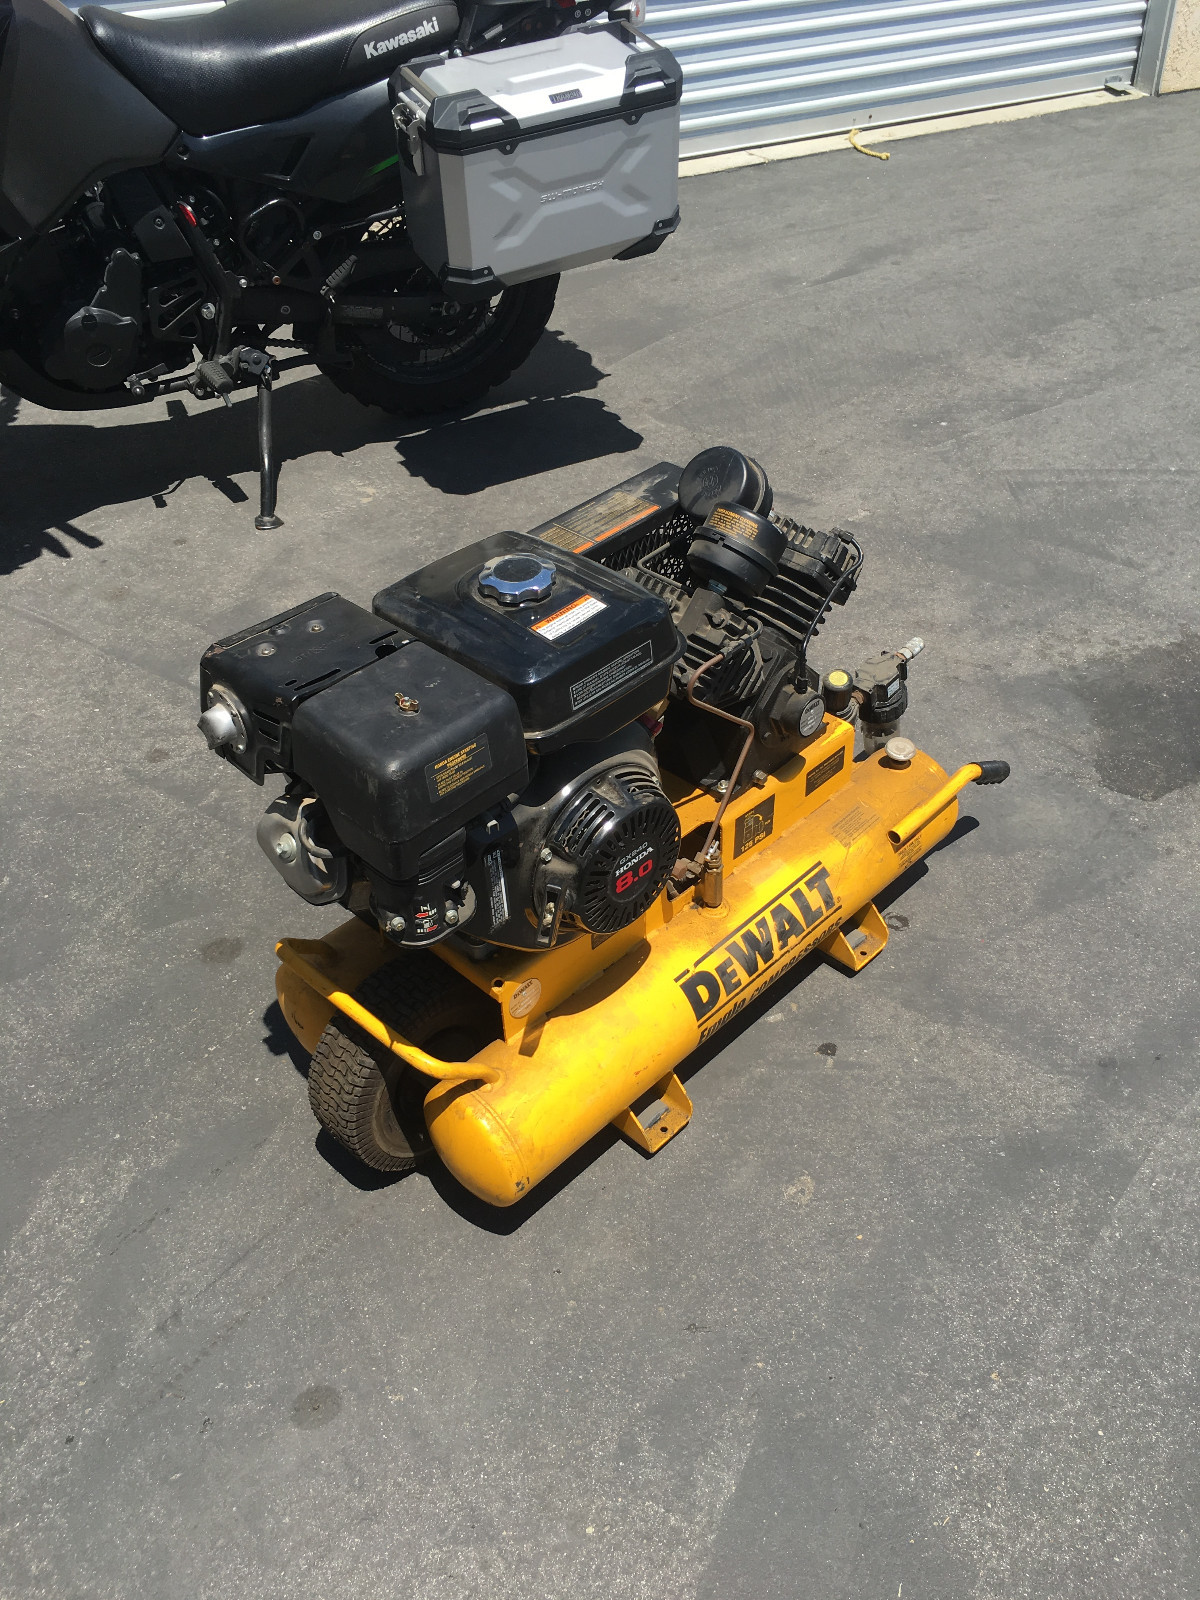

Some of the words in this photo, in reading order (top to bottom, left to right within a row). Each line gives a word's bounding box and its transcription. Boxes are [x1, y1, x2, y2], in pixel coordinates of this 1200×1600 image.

[363, 16, 440, 60] Kawasaki
[740, 840, 753, 852] 125
[754, 830, 766, 844] PSI
[615, 846, 654, 877] HONDA
[615, 859, 653, 894] 8.0
